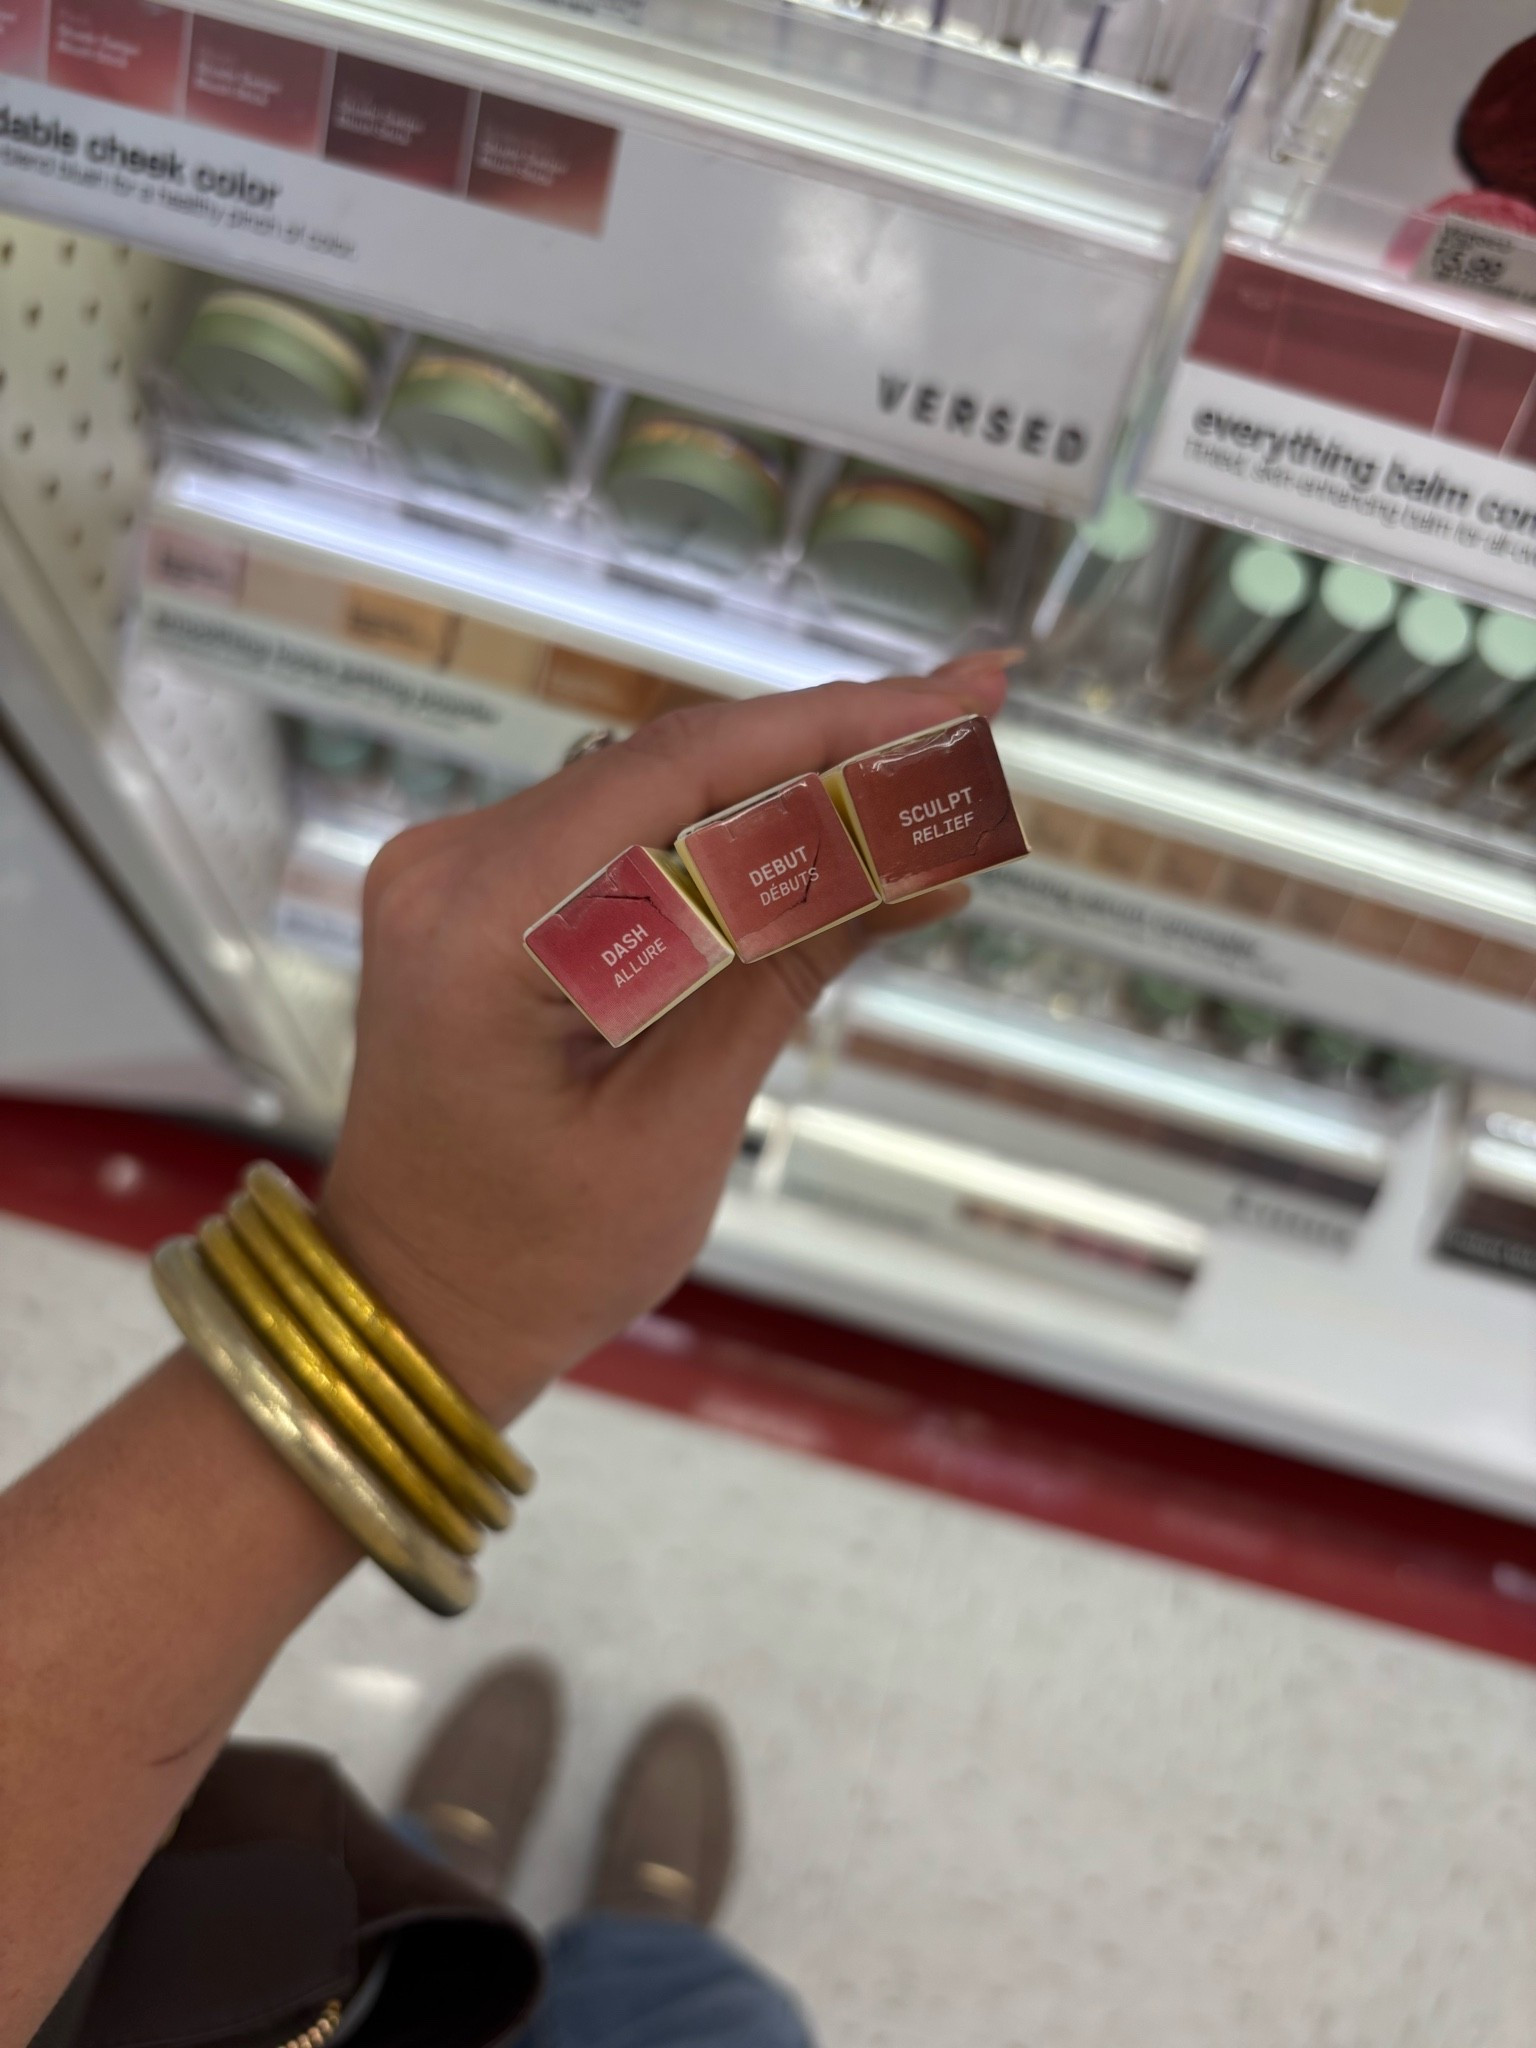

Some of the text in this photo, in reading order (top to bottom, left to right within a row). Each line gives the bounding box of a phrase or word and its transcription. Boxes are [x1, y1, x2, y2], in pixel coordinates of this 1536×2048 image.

[87, 133, 183, 183] cheek
[193, 163, 281, 211] color
[877, 370, 1088, 466] VERSED
[1191, 404, 1377, 494] everything
[1382, 454, 1469, 517] balm
[899, 787, 972, 827] SCULPT
[912, 811, 974, 846] RELIEF
[749, 846, 807, 888] DEBUT
[760, 867, 819, 906] DÉBUTS
[601, 924, 649, 967] DASH
[614, 938, 667, 988] ALLURE
